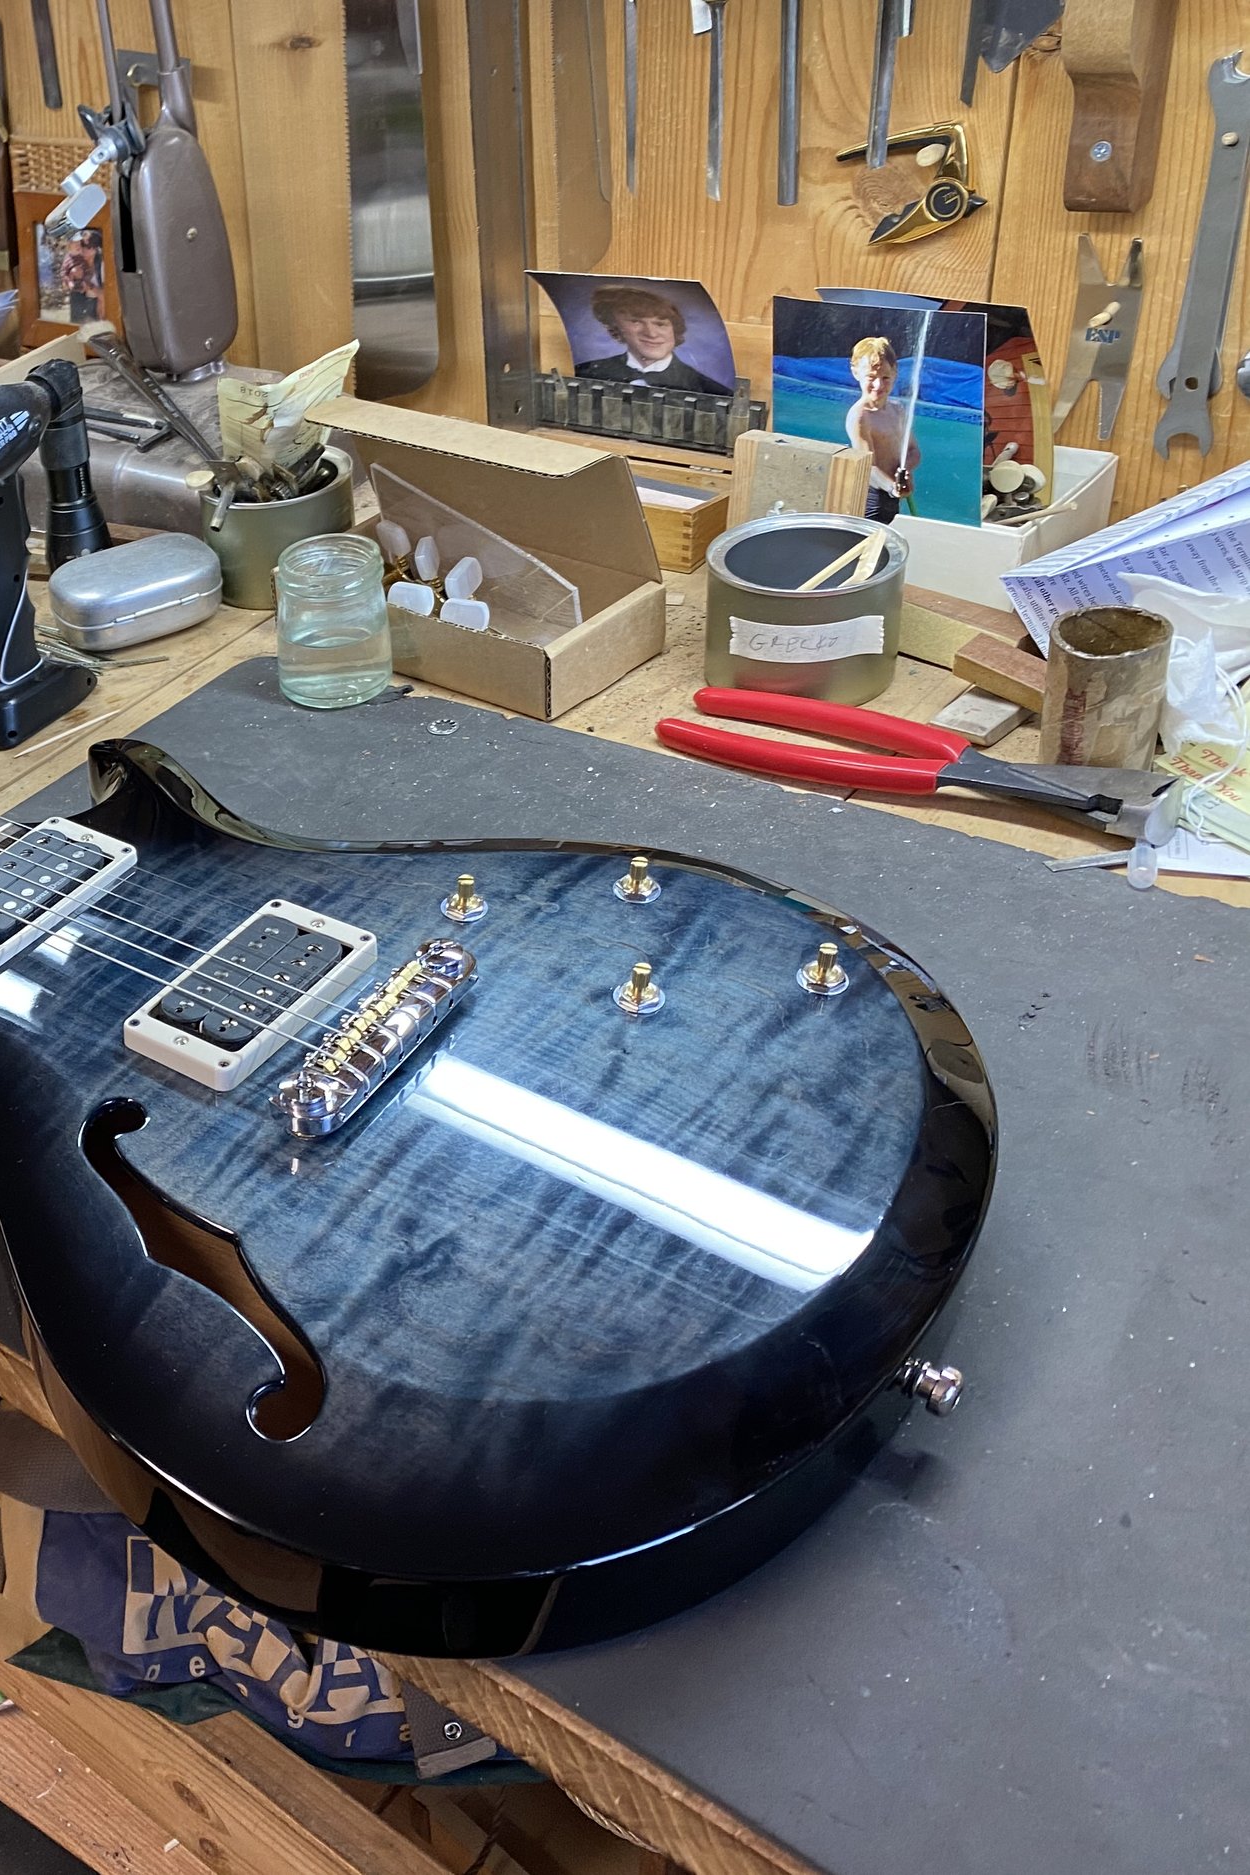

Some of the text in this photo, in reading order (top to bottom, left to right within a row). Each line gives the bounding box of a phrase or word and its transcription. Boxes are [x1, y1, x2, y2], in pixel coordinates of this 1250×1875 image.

[1039, 588, 1055, 608] other
[1200, 748, 1248, 778] Thak
[1215, 781, 1242, 802] You
